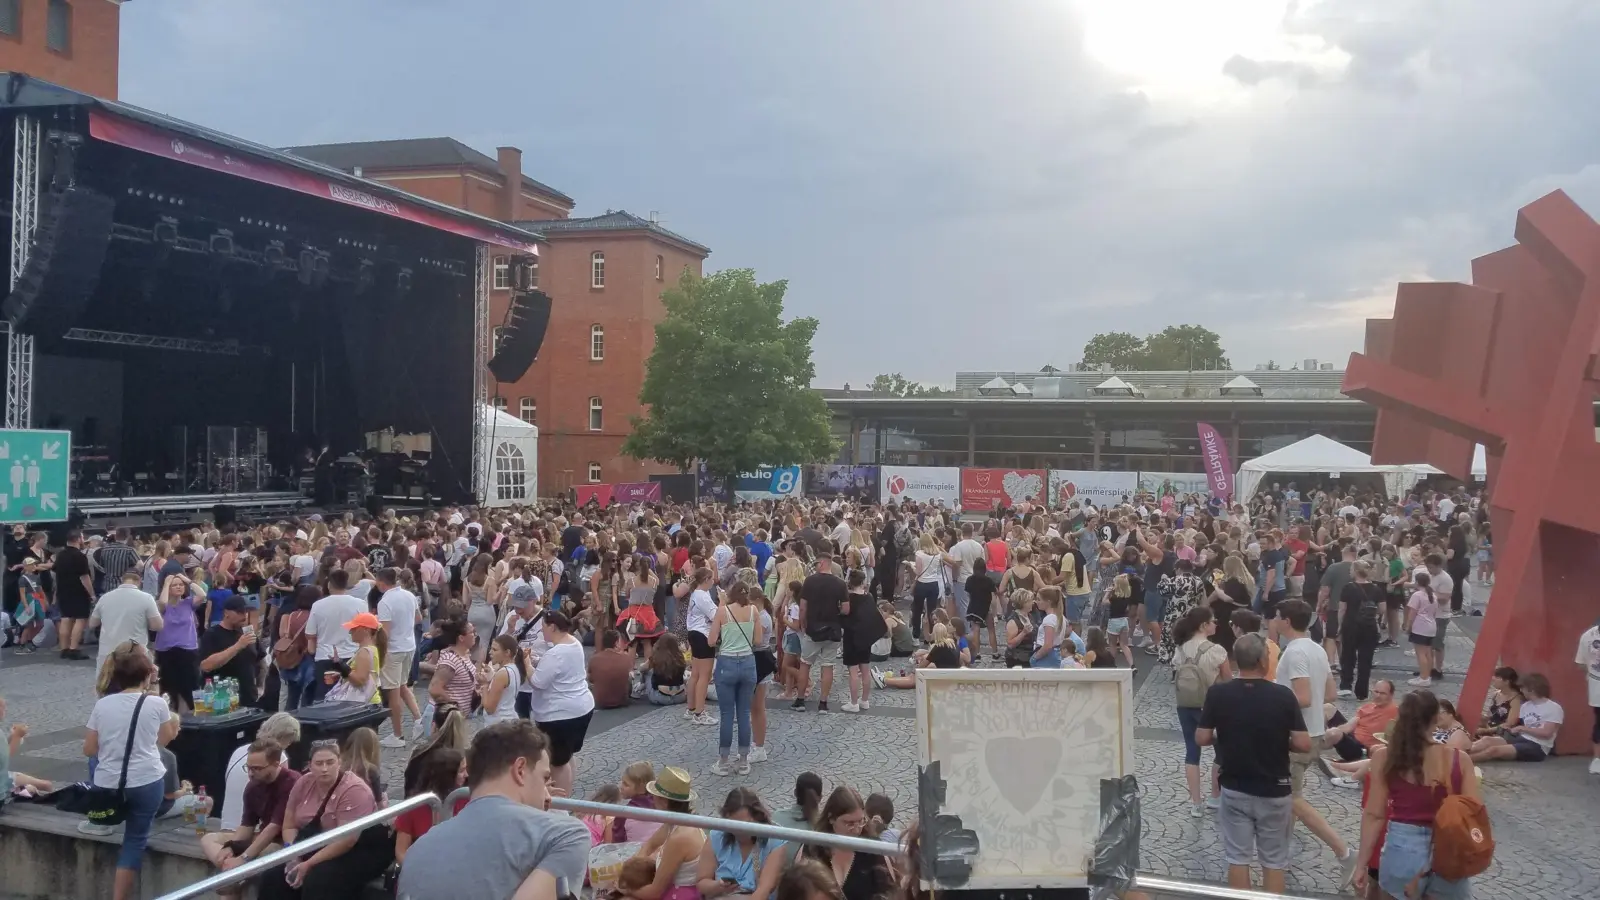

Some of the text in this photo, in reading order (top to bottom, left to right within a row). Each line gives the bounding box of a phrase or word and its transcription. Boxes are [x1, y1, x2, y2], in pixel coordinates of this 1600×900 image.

[373, 196, 400, 214] OPEN
[736, 468, 794, 493] adio 8
[906, 481, 955, 491] kammerspiele
[1076, 486, 1133, 497] kammerspiele
